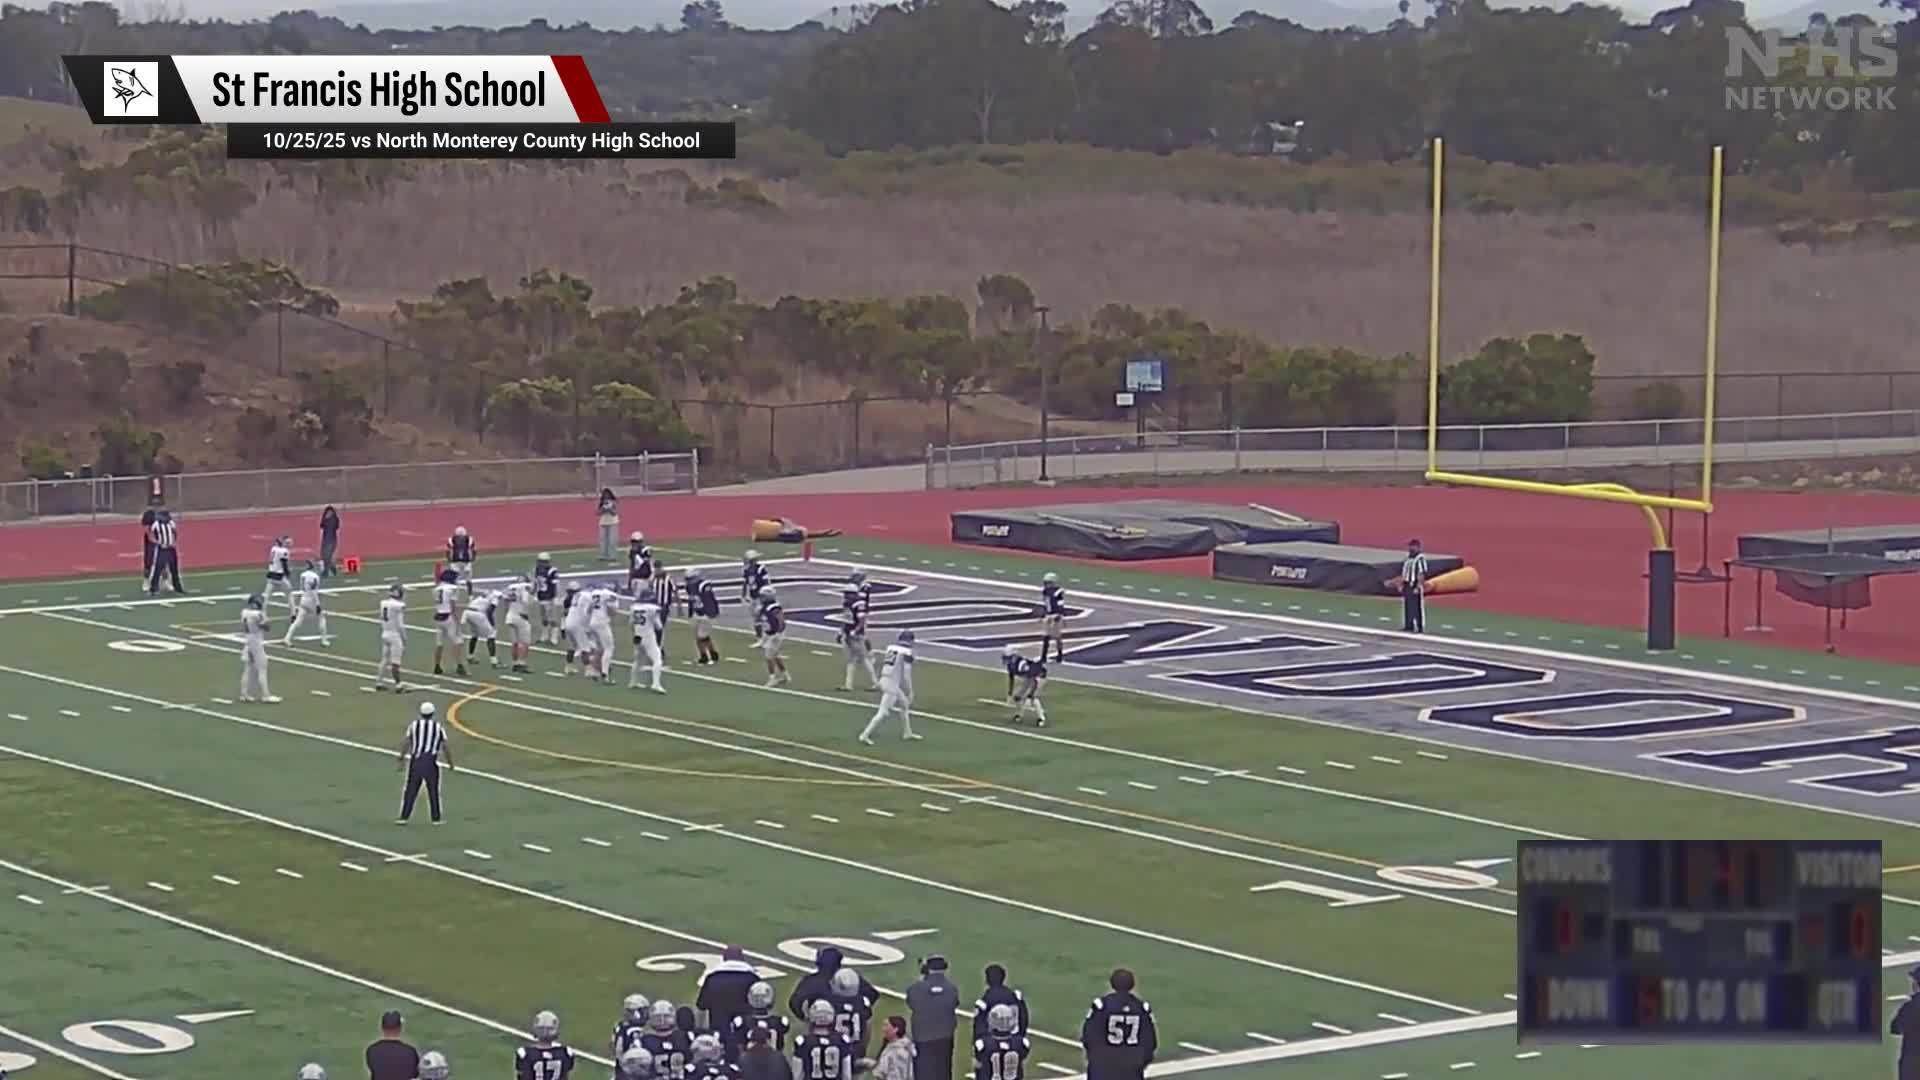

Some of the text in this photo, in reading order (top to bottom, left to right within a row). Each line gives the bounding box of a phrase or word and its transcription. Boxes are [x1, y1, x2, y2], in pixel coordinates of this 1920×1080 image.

[1108, 1015, 1140, 1044] 57
[533, 1060, 562, 1080] 17
[811, 1046, 840, 1078] 19
